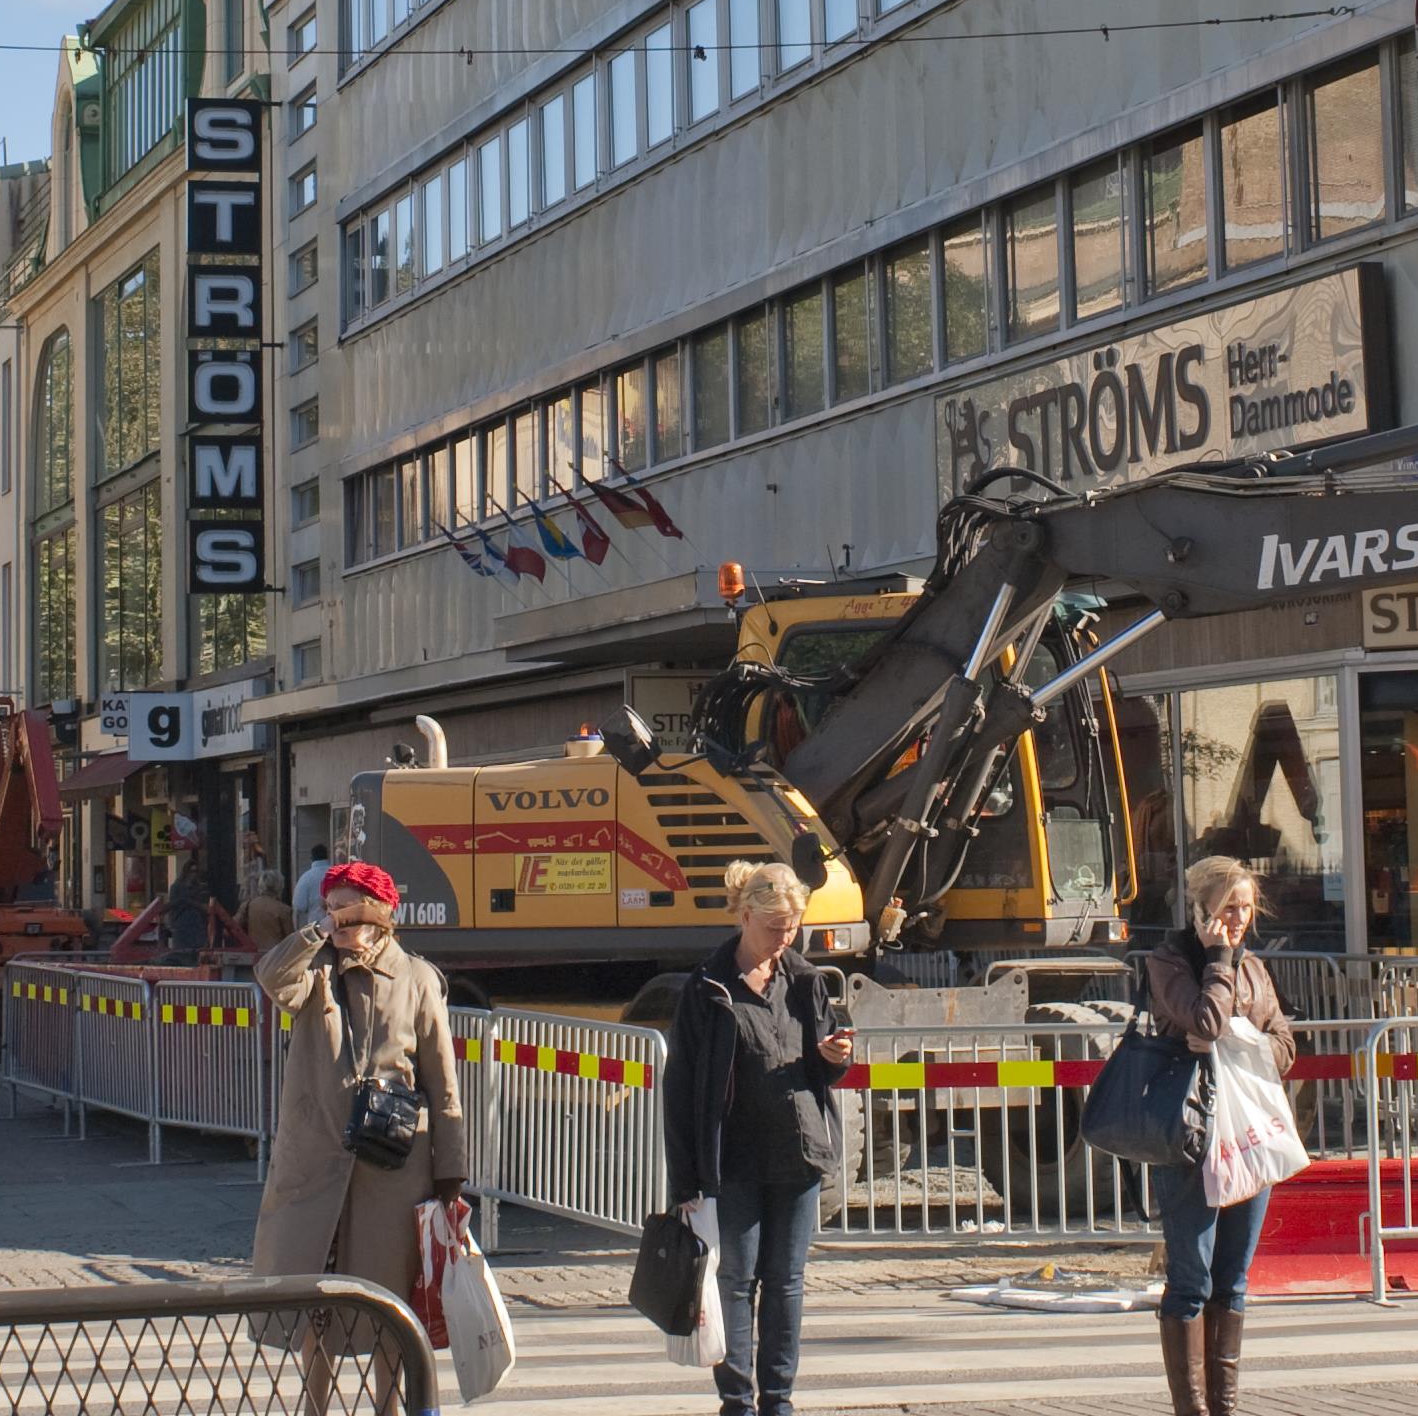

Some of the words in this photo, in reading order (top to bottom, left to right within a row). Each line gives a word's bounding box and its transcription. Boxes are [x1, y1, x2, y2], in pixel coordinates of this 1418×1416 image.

[193, 107, 256, 584] STRÖMS
[1226, 338, 1289, 388] Herr-
[1007, 344, 1211, 484] STRÖMS
[1229, 370, 1355, 440] Dammode
[102, 699, 128, 712] KA
[147, 705, 181, 748] g
[484, 787, 610, 811] VOLVO
[392, 902, 446, 925] W160B
